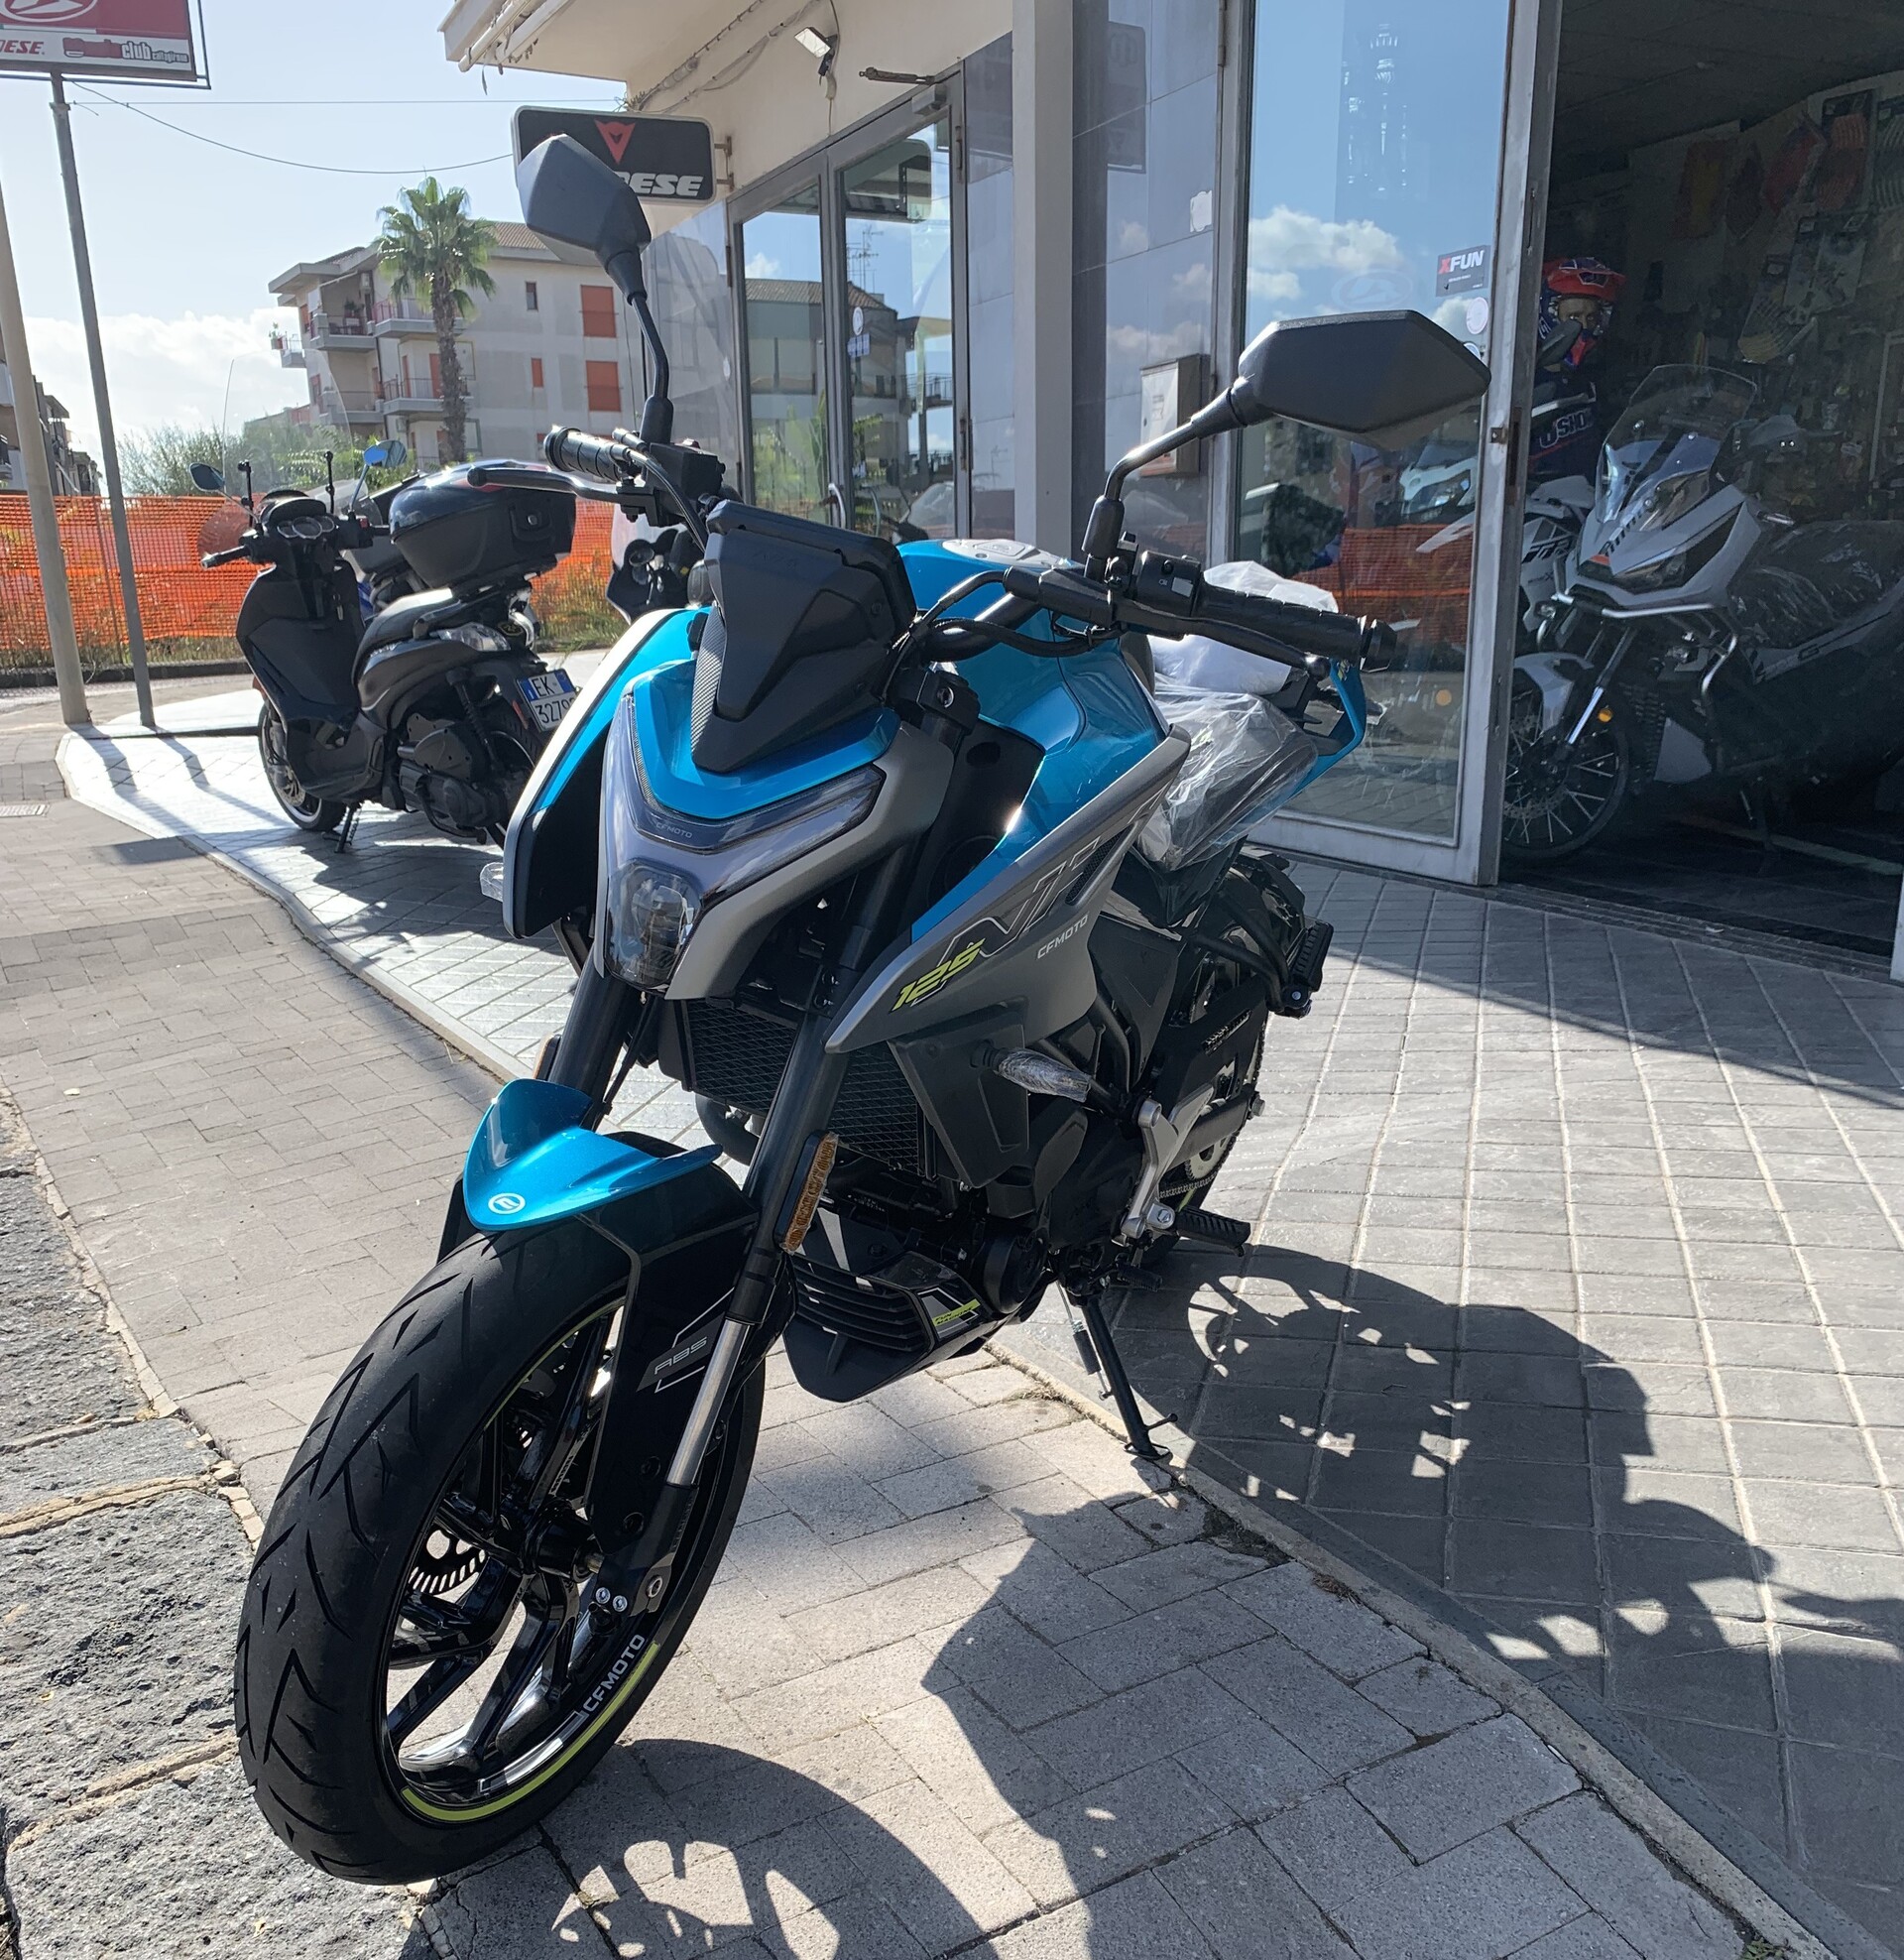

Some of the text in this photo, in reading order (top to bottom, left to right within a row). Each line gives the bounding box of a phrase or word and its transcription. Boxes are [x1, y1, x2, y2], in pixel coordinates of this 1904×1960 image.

[0, 40, 44, 55] ESE
[121, 42, 152, 61] club
[1438, 250, 1484, 274] XFUN
[532, 676, 554, 697] EK
[536, 697, 575, 724] 3279
[655, 821, 692, 839] CFMOTO
[1036, 914, 1089, 960] CFMOTO
[891, 938, 986, 1012] 125
[654, 1336, 708, 1376] ABS
[582, 1634, 647, 1714] CFMOTO
